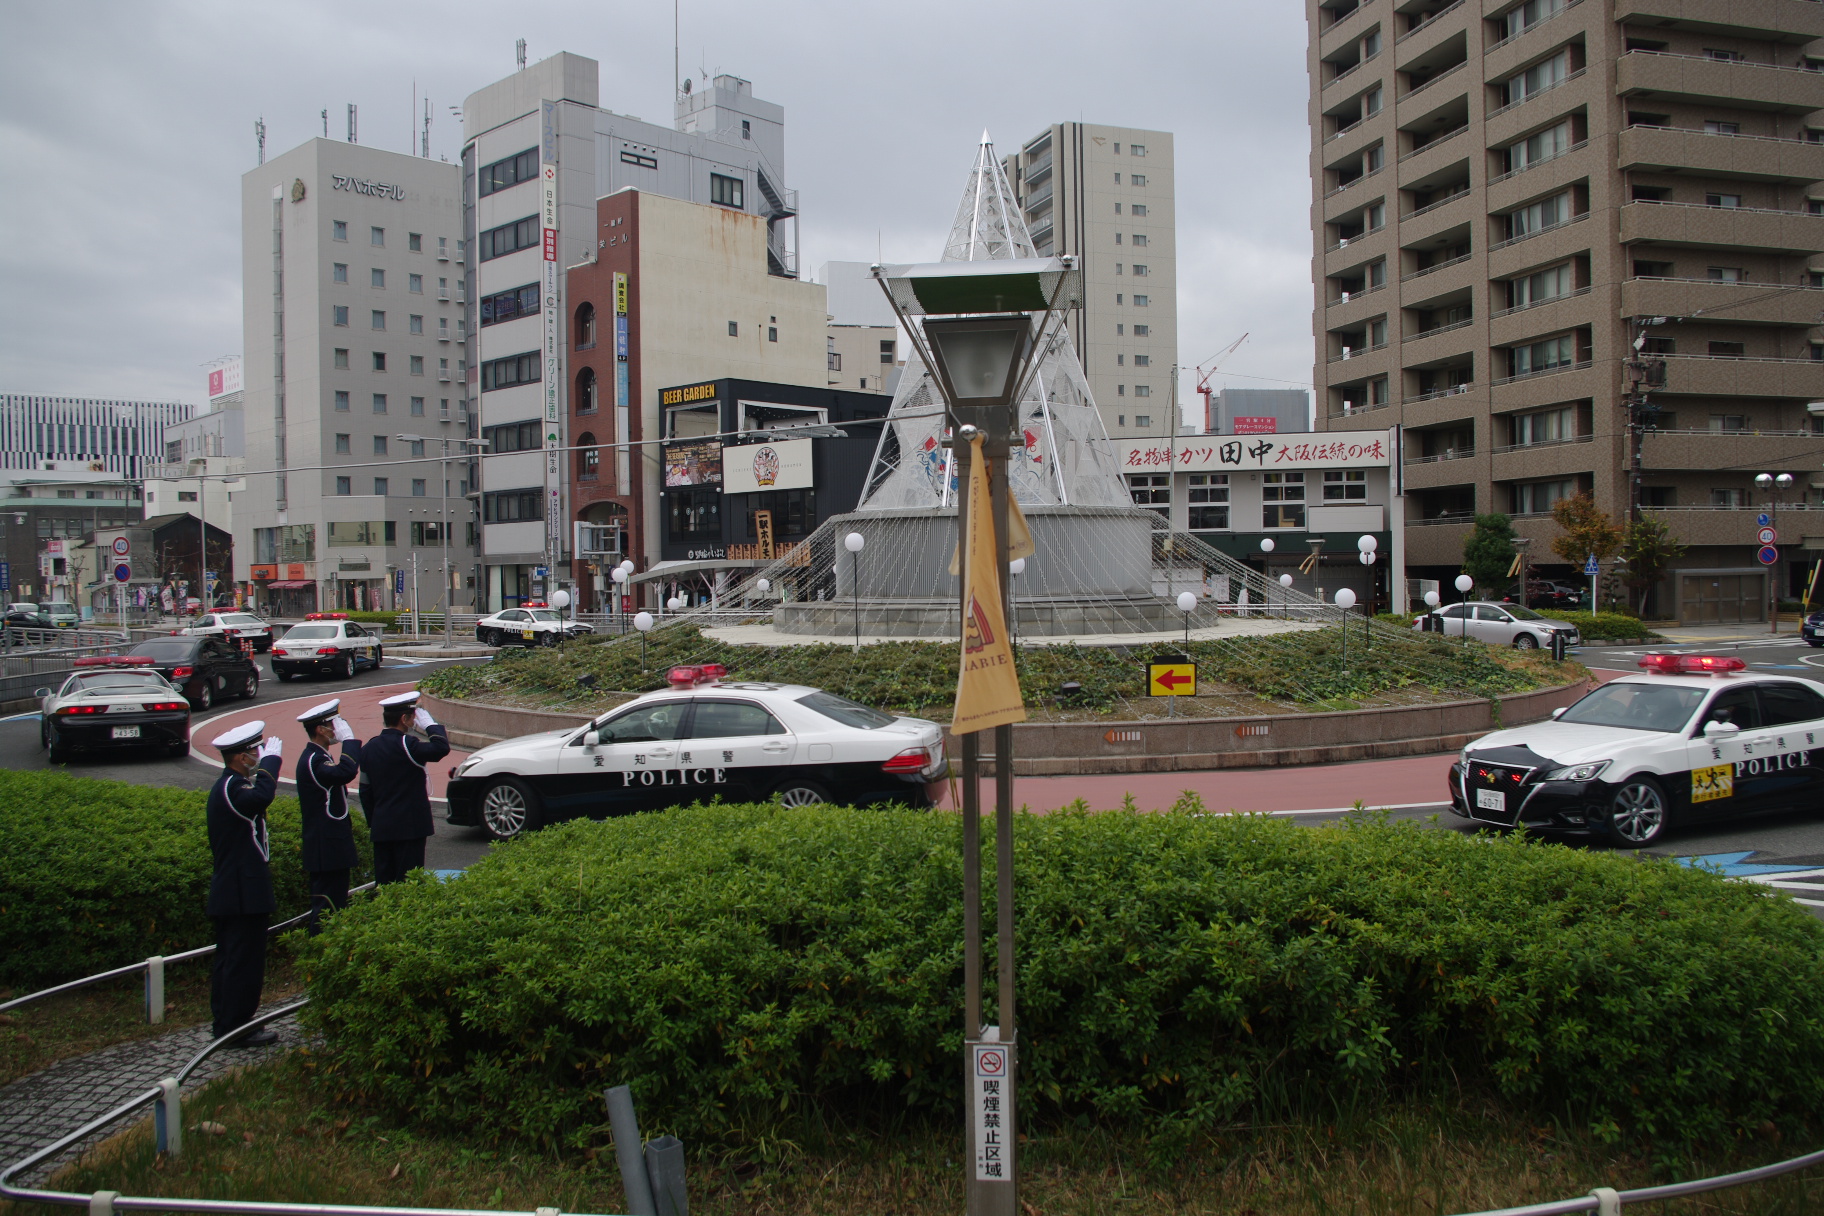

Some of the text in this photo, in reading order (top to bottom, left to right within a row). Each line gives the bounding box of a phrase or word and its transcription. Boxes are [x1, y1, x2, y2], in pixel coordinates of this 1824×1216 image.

[332, 174, 405, 201] アパホテル
[546, 190, 554, 225] 日本生命
[545, 230, 555, 261] 個別指導
[663, 383, 715, 405] BEER GARDEN
[1125, 438, 1386, 467] 名物串カツ 田中 大阪伝統の味
[116, 541, 126, 551] 40
[1761, 531, 1773, 541] 40
[118, 728, 138, 737] 43-58
[593, 750, 734, 767] 愛知県警
[1735, 750, 1810, 778] POLICE
[622, 767, 727, 787] POLICE
[983, 1080, 1002, 1178] 喫煙禁止区域
